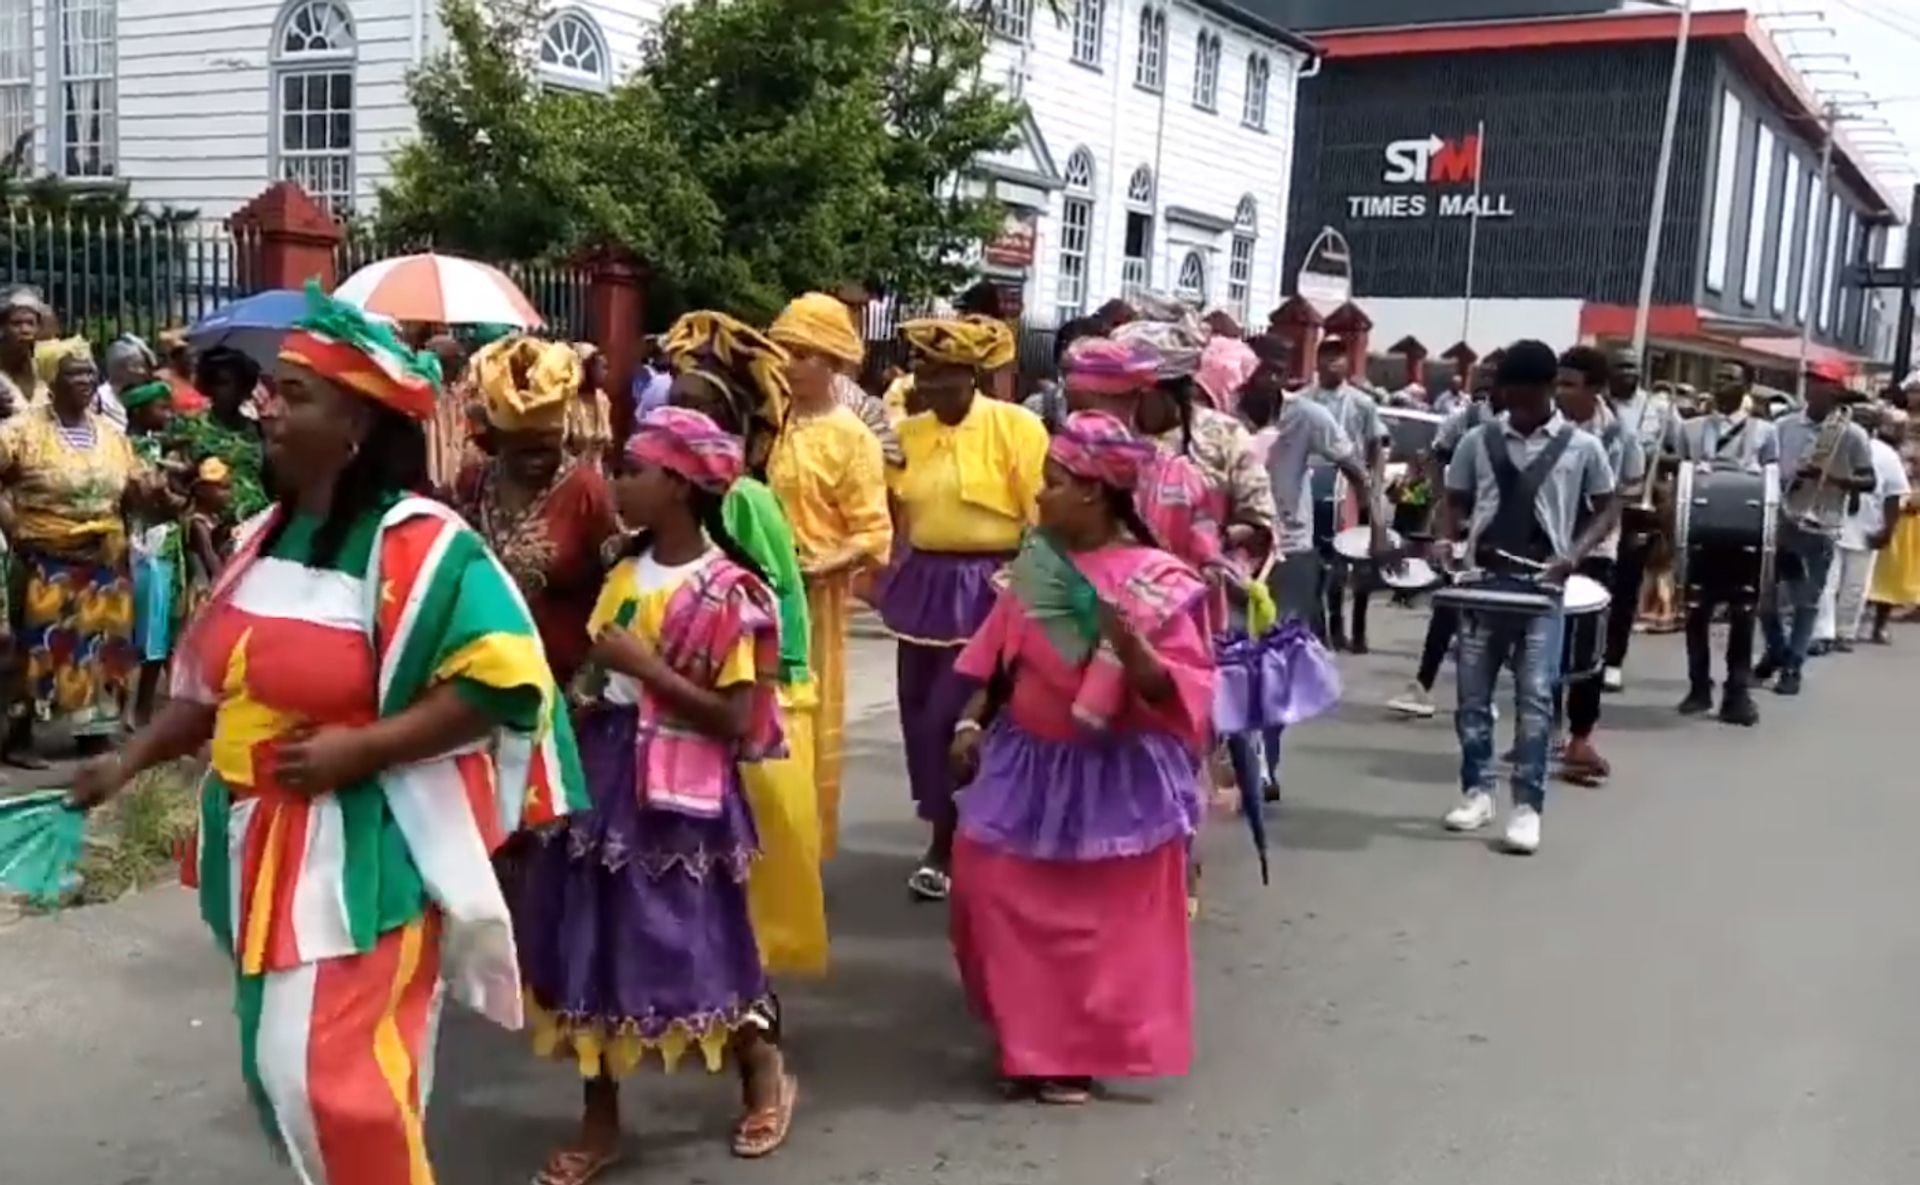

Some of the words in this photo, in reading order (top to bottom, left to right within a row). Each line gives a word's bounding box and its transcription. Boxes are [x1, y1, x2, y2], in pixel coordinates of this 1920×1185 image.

[1384, 134, 1482, 183] STM
[1348, 195, 1426, 217] TIMES
[1439, 194, 1514, 216] MALL
